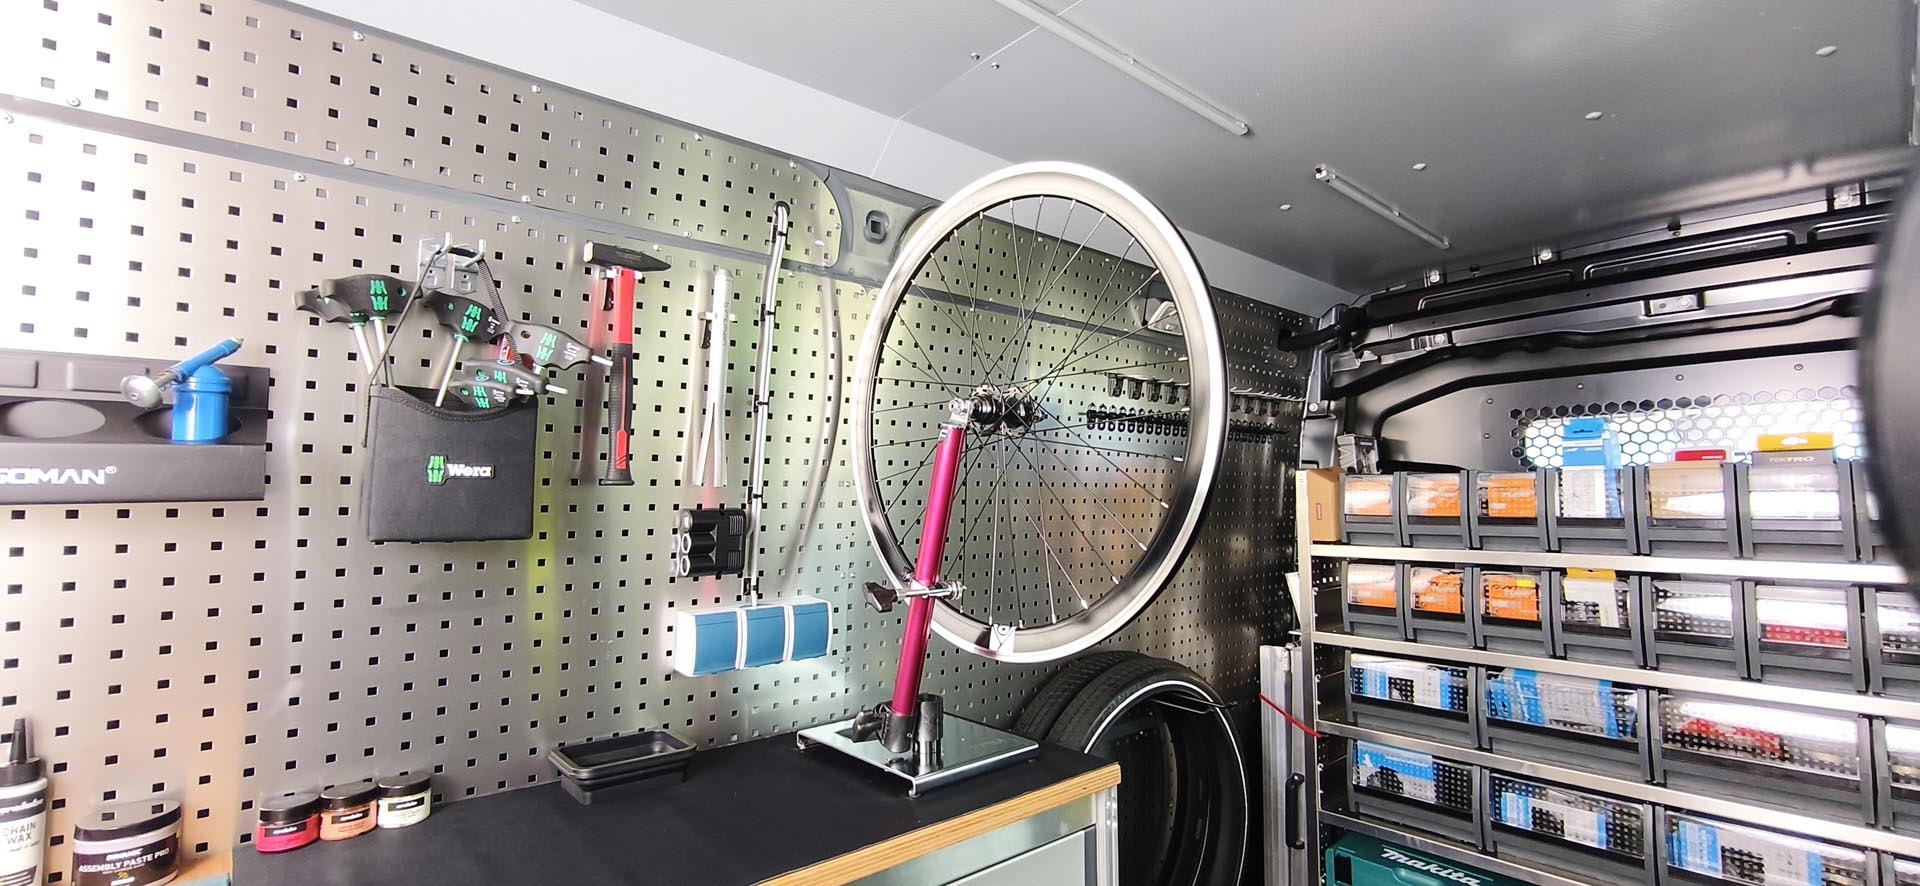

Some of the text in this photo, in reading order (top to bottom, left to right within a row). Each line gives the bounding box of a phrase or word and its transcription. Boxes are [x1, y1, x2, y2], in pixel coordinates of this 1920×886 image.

[446, 463, 492, 477] Wera
[3, 821, 37, 837] CHAIN
[7, 832, 33, 845] WAX
[79, 861, 122, 873] ASSEMBLY
[123, 853, 154, 868] PASTE
[154, 847, 170, 859] PRO
